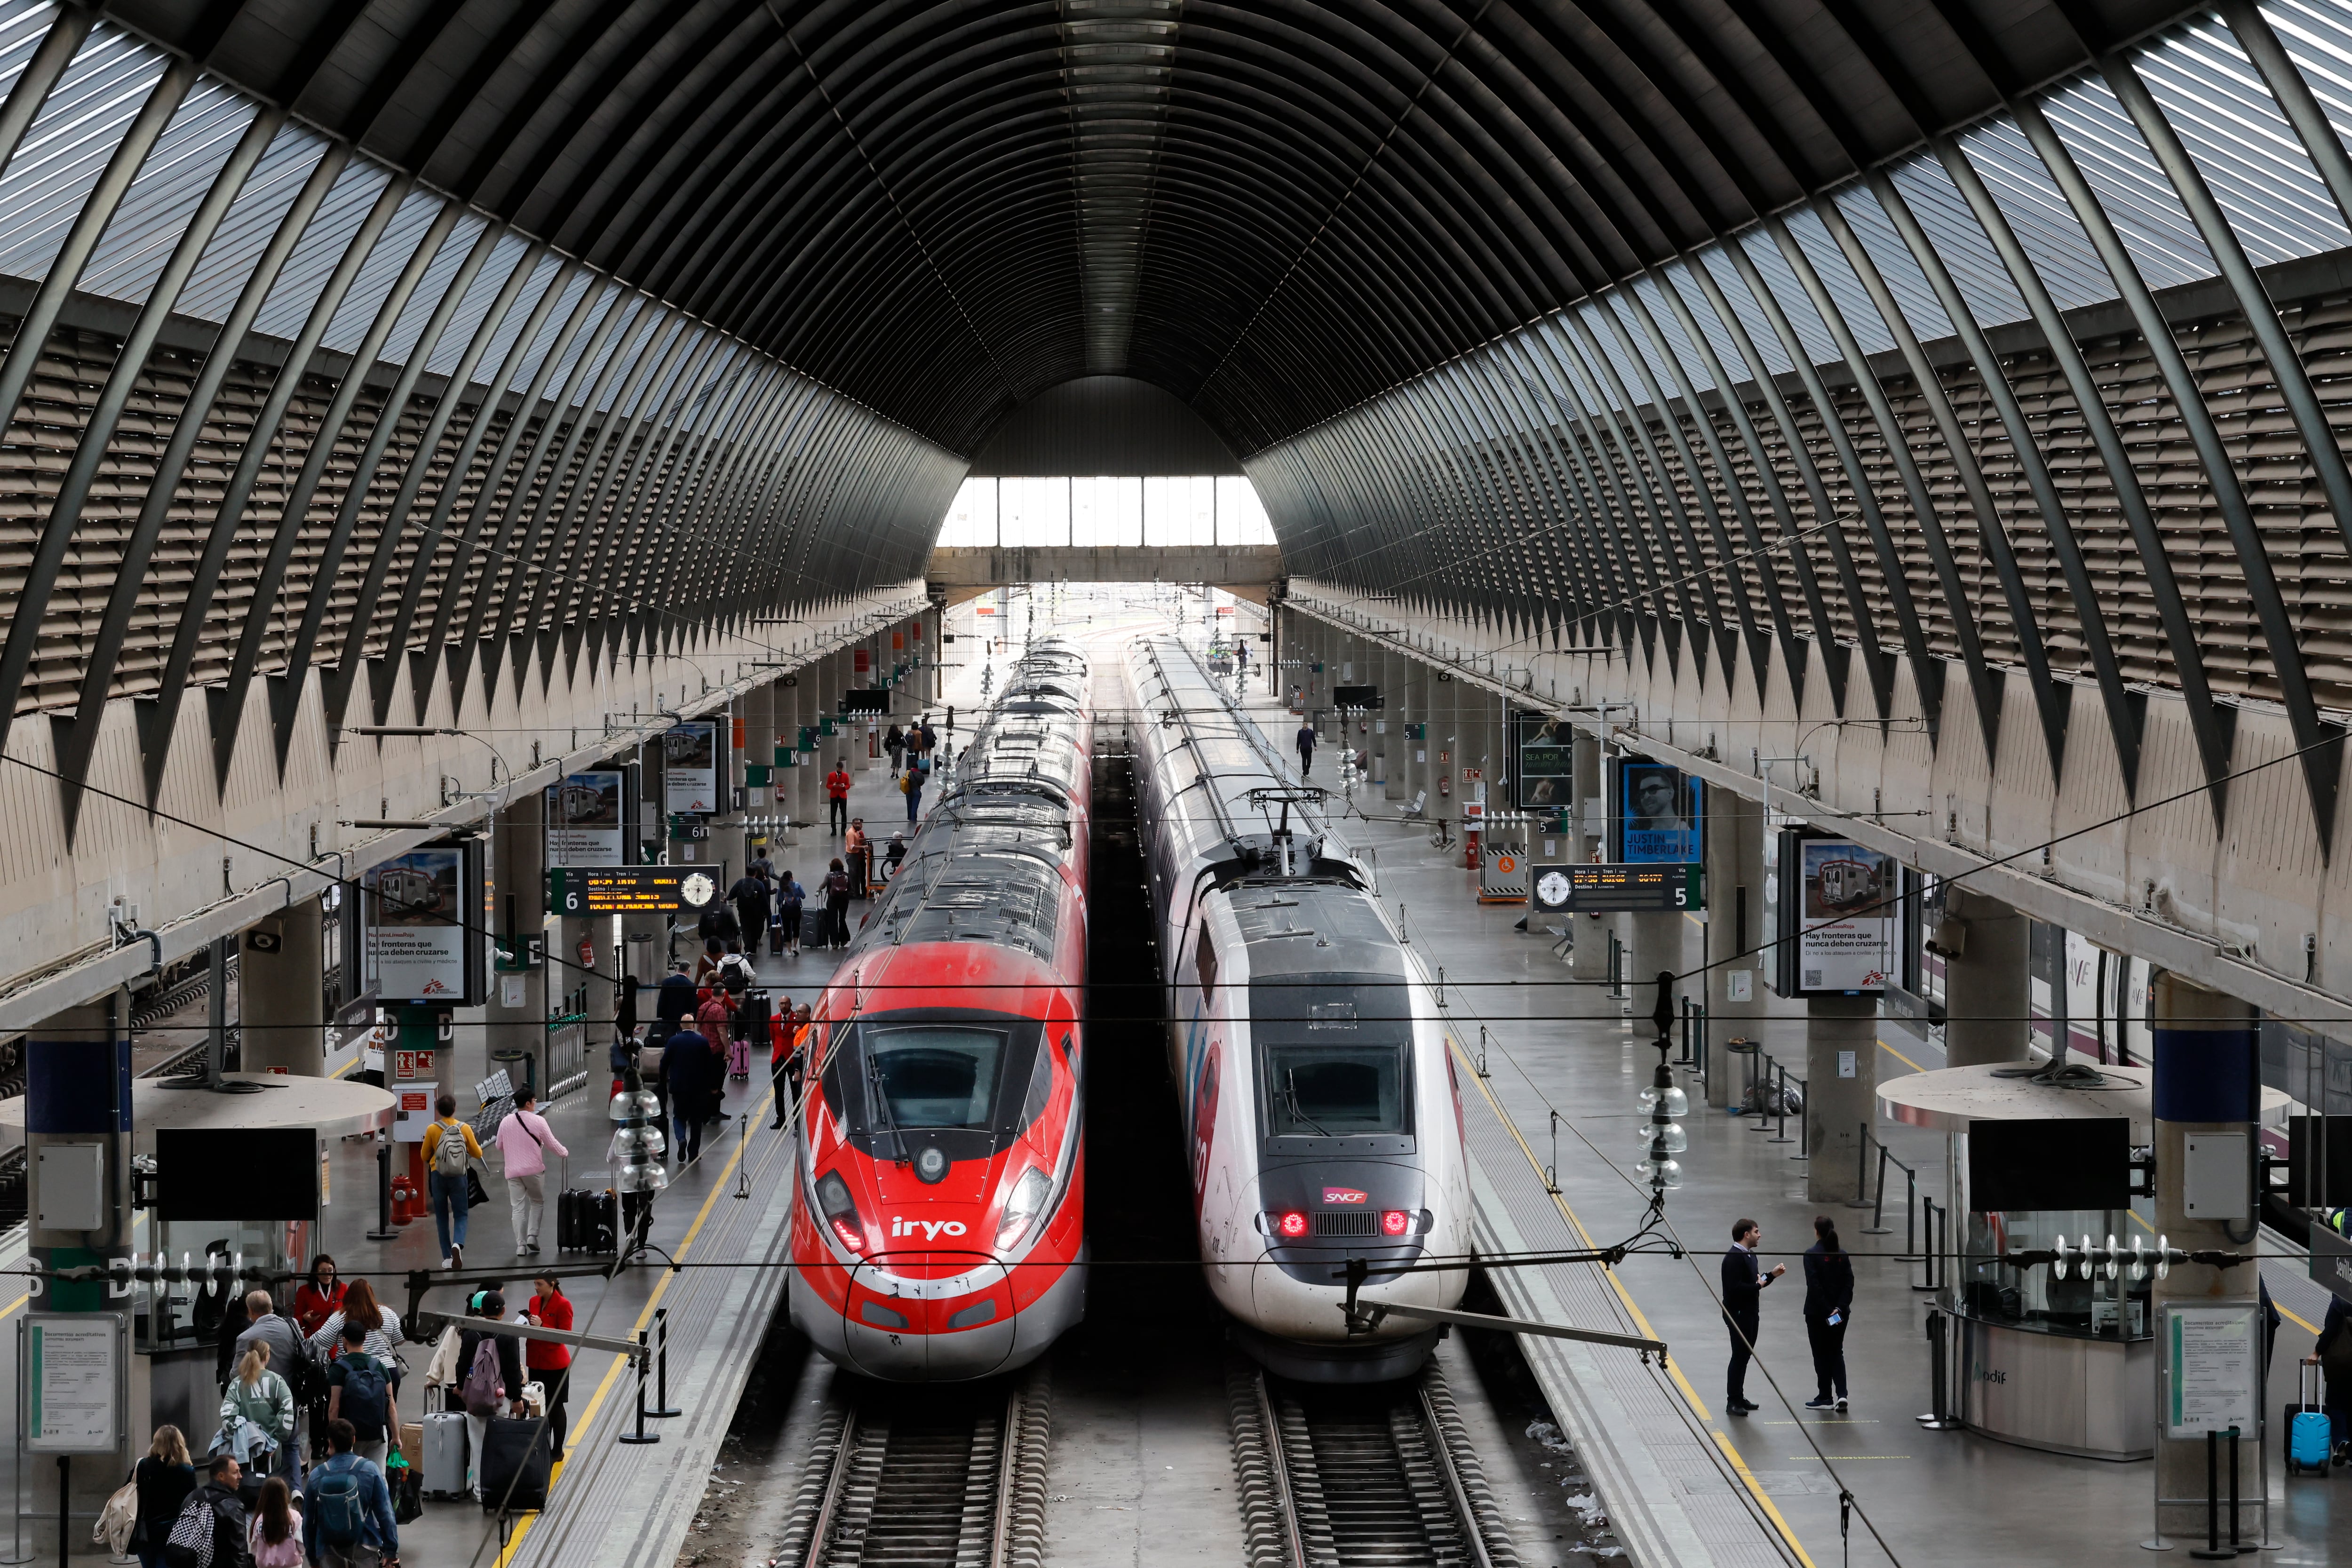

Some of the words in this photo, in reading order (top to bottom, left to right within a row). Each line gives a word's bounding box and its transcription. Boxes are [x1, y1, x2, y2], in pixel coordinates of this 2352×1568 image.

[887, 679, 892, 689] Q
[831, 722, 839, 733] M
[791, 750, 798, 764] K
[767, 769, 772, 783] J
[692, 827, 699, 837] 6
[1540, 822, 1546, 832] 5
[1627, 834, 1665, 844] JUSTIN
[1627, 845, 1694, 854] TIMBERLAKE
[566, 892, 578, 910] 6
[1676, 888, 1687, 906] 5
[529, 940, 541, 964] E
[2068, 957, 2090, 988] AVE
[2131, 987, 2144, 1006] AVE
[384, 1014, 398, 1041] D
[438, 1014, 453, 1041] D
[1325, 1193, 1364, 1202] SNCF
[892, 1216, 966, 1242] iryo
[2336, 1257, 2352, 1284] Sevilla
[1983, 1370, 2006, 1384] adif
